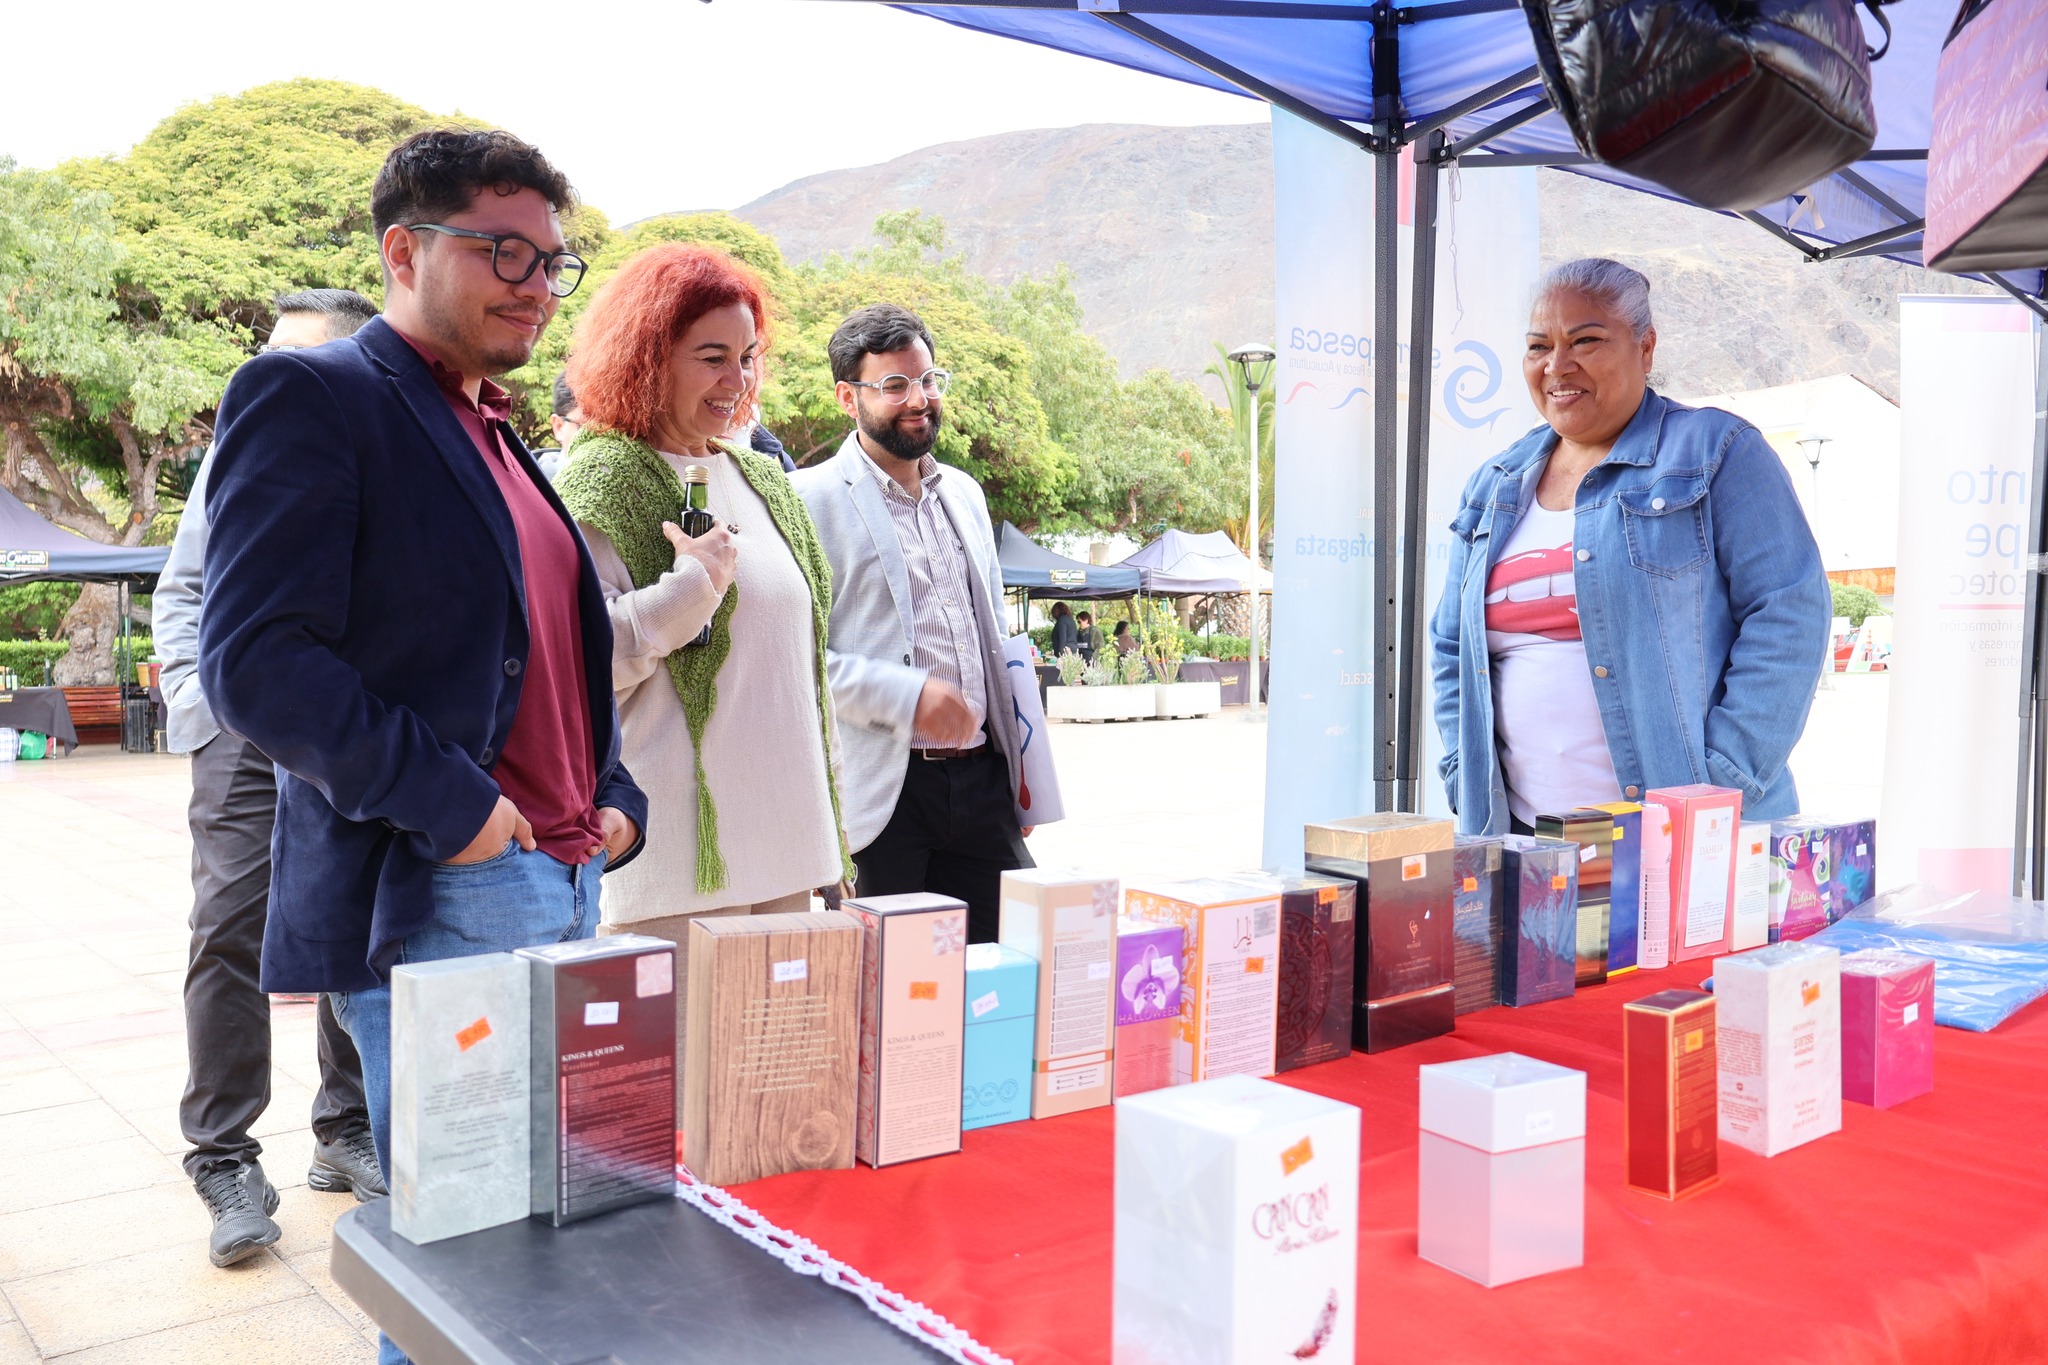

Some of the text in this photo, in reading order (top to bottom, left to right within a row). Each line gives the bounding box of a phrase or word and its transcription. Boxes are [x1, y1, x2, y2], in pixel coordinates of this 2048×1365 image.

[1700, 845, 1724, 856] DAHLIA
[1119, 1005, 1180, 1025] HALLOWEEN
[887, 1036, 909, 1045] KINGS
[917, 1031, 945, 1041] QUEENS
[561, 1044, 625, 1062] KINGS & QUEENS
